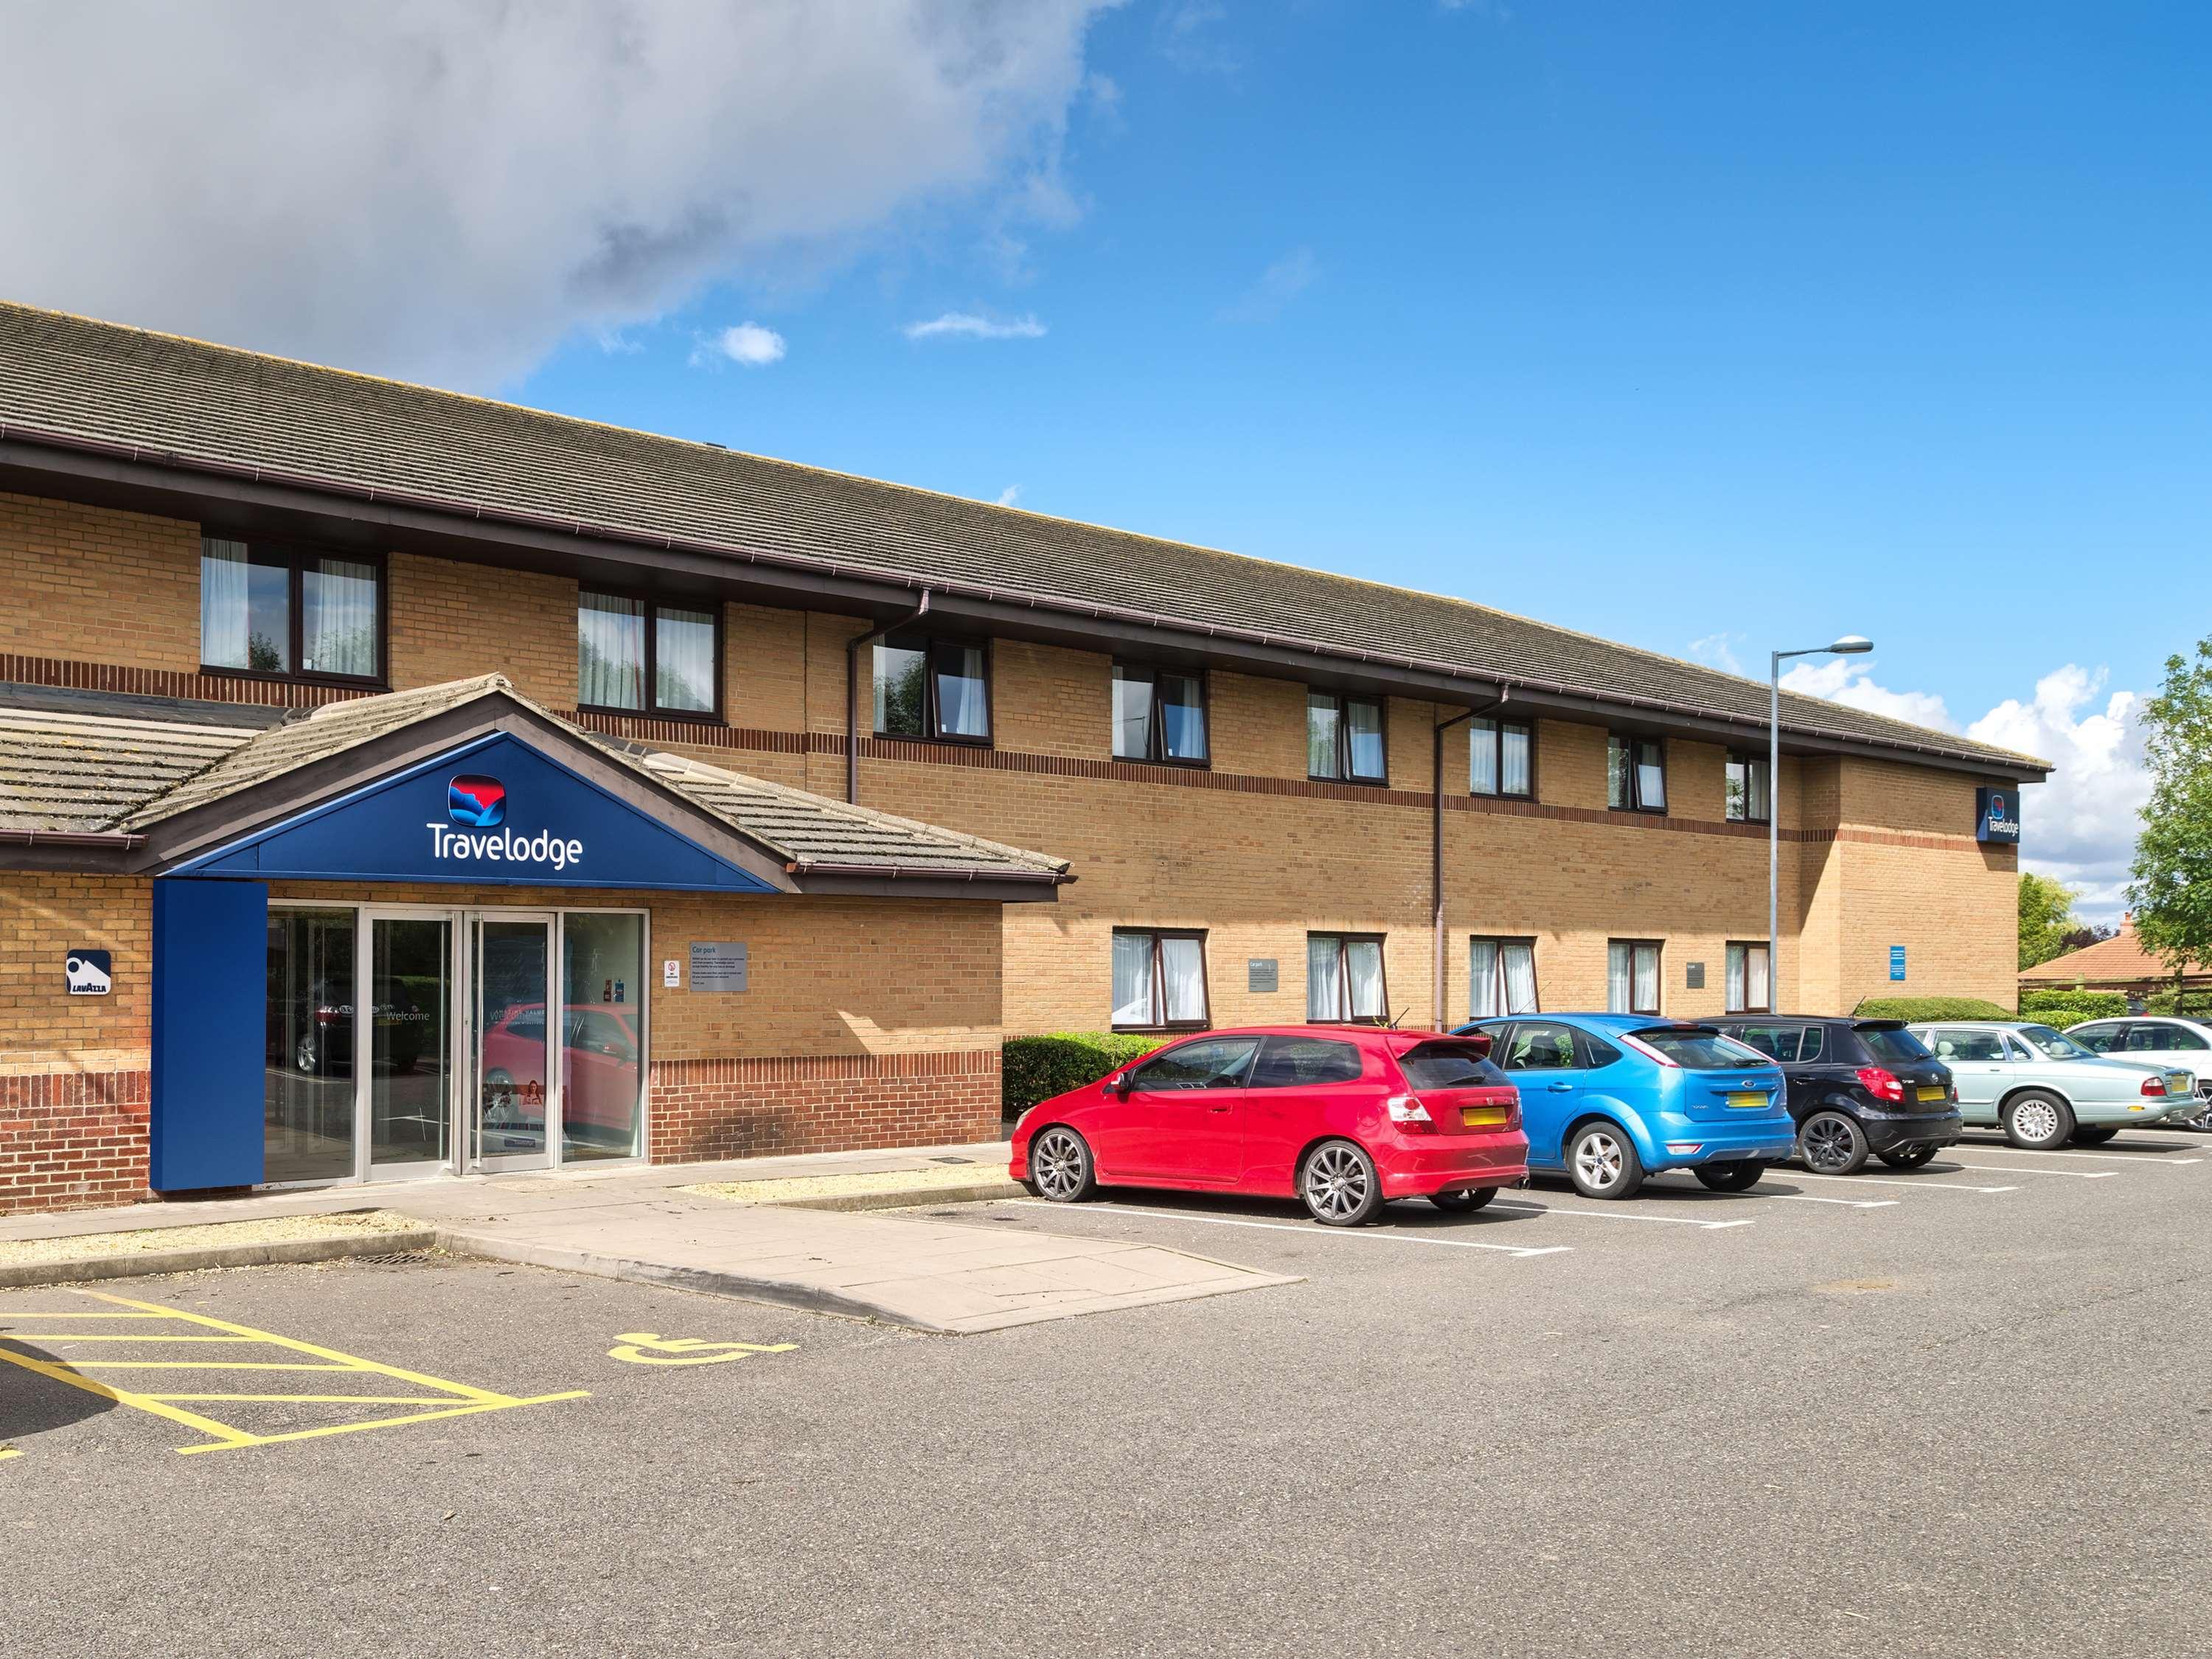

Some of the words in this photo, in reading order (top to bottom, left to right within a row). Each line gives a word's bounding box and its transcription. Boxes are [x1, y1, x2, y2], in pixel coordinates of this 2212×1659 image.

[1988, 816, 2019, 837] Travelodge
[426, 823, 583, 871] Travelodge
[72, 983, 106, 992] LAVAZZA
[386, 1010, 431, 1021] Welcome
